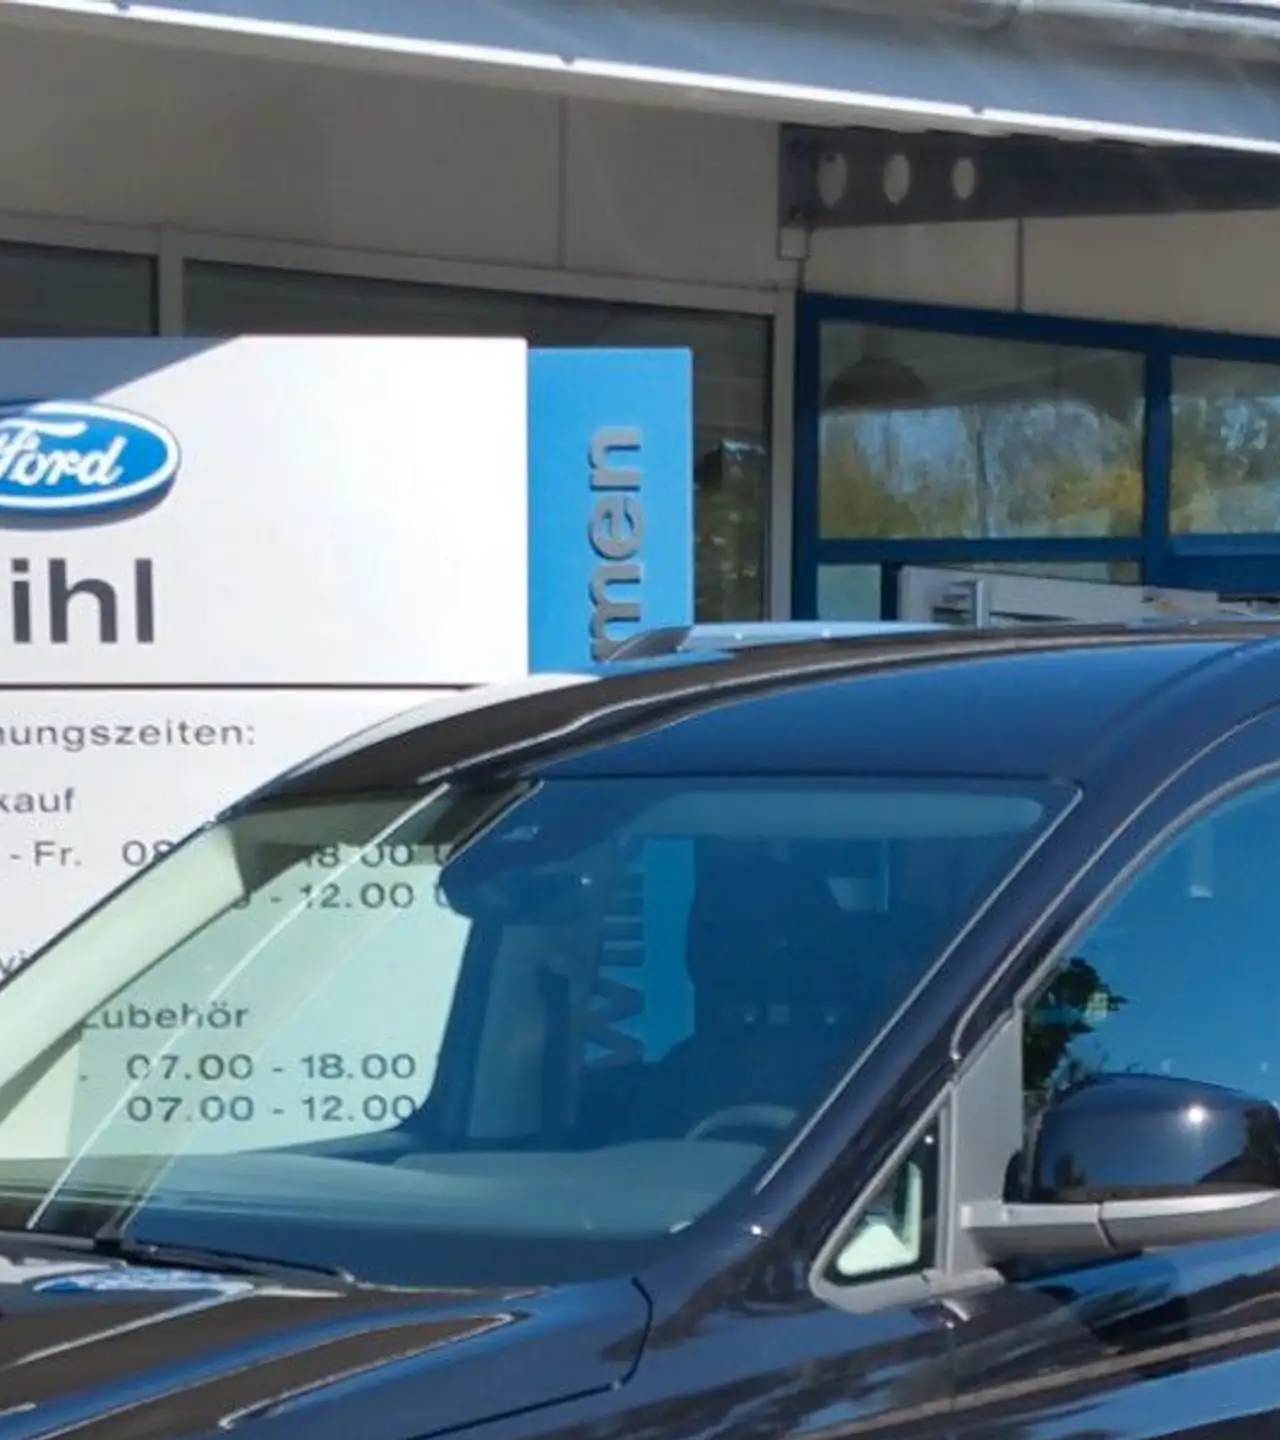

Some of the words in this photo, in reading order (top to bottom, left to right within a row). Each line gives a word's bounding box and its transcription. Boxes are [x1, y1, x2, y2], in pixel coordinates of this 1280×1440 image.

[35, 841, 82, 867] Fr.
[300, 881, 414, 908] 12.00
[126, 1053, 254, 1081] 07.00
[301, 1053, 417, 1080] 18.00
[127, 1095, 255, 1122] 07.00
[302, 1094, 417, 1122] 12.00
